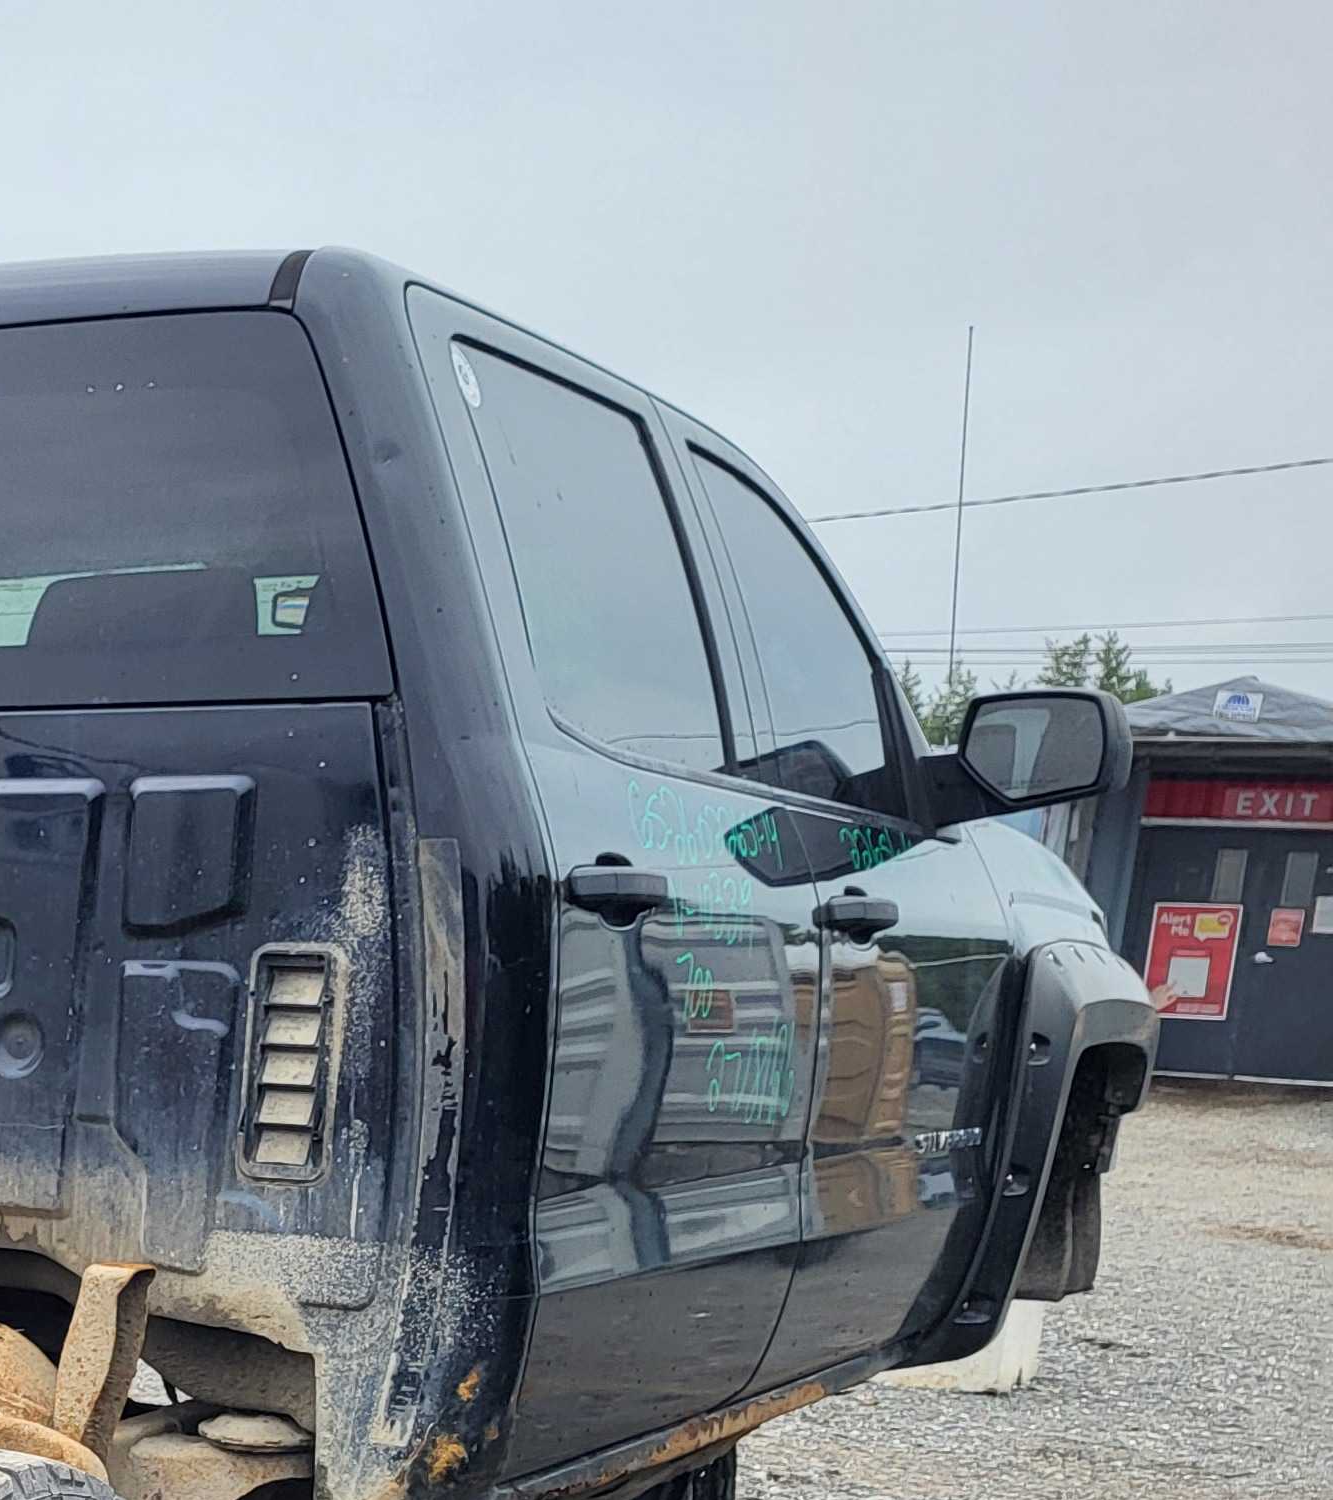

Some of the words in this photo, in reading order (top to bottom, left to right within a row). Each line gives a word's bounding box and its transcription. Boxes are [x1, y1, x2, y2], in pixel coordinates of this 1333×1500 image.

[1236, 791, 1319, 817] EXIT
[1159, 912, 1191, 926] Alert
[677, 951, 715, 1024] 700
